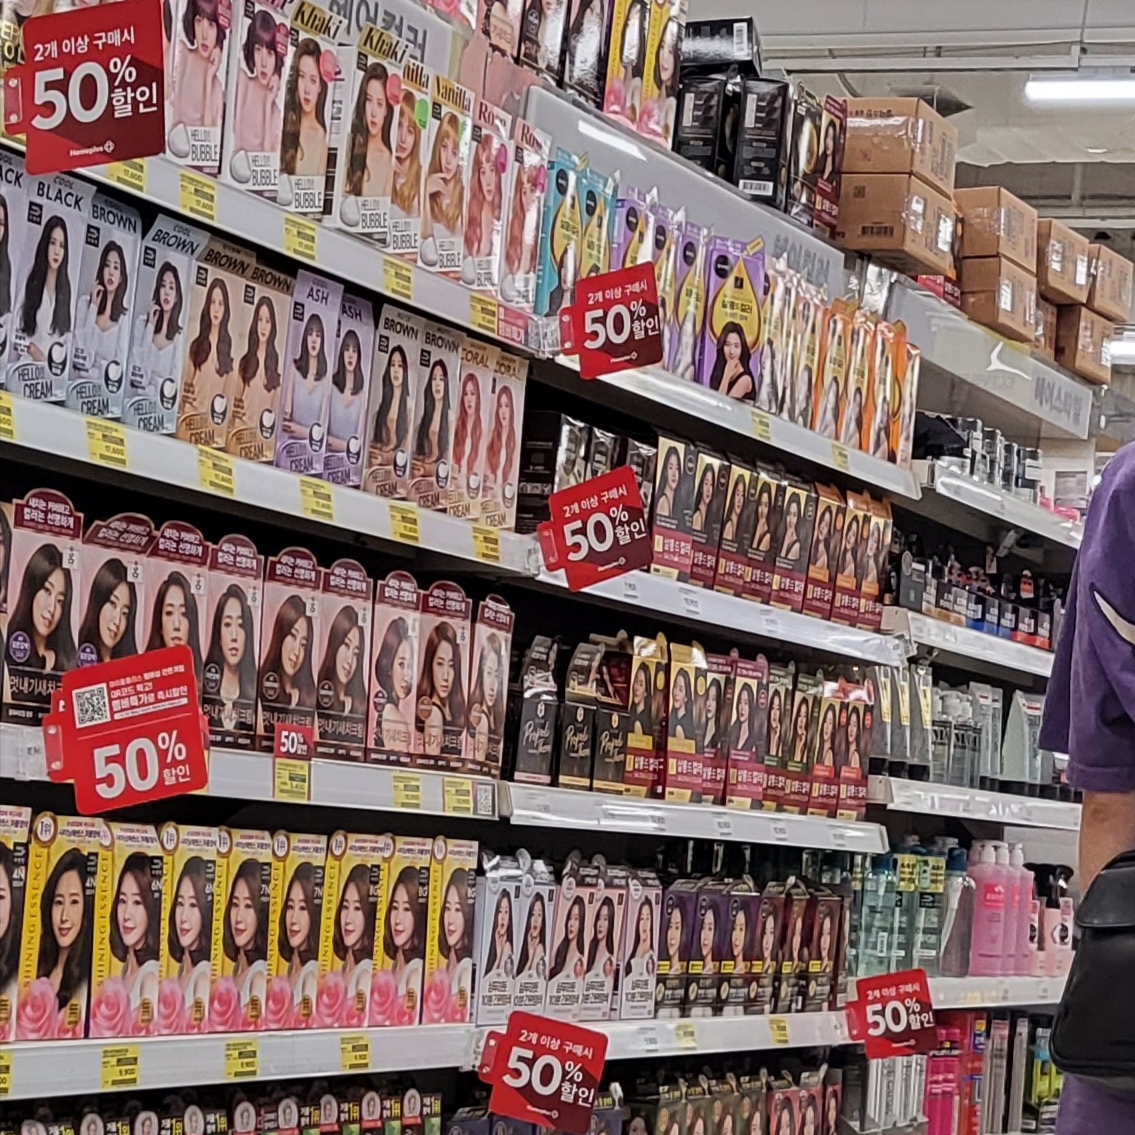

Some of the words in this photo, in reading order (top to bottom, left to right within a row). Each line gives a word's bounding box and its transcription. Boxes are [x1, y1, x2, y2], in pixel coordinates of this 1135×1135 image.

[293, 3, 343, 41] Khaki
[34, 43, 58, 62] 2개
[62, 35, 90, 56] 이상
[93, 26, 135, 50] 구매시
[362, 28, 410, 69] Khaki
[110, 82, 158, 119] 할인
[434, 75, 473, 114] Vanilla
[191, 144, 219, 163] BUBBLE
[53, 175, 75, 190] COOL
[251, 169, 278, 187] BUBBLE
[37, 181, 85, 211] BLACK
[294, 191, 324, 209] BUBBLE
[92, 203, 138, 233] BROWN
[361, 212, 389, 231] BUBBLE
[152, 228, 200, 256] BROWN
[204, 249, 250, 276] BROWN
[251, 266, 293, 292] BROWN
[588, 292, 603, 305] 2개
[604, 287, 622, 301] 이상
[624, 279, 648, 296] 구매시
[306, 286, 330, 305] ASH
[342, 301, 363, 322] ASH
[383, 316, 419, 340] BROWN
[632, 315, 660, 340] 할인
[425, 331, 461, 356] BROWN
[23, 382, 53, 400] CREAM
[81, 397, 109, 416] CREAM
[138, 414, 165, 432] CREAM
[563, 502, 580, 518] 2개
[581, 495, 598, 510] 이상
[600, 484, 628, 503] 구매시
[615, 518, 647, 546] 할인
[163, 764, 191, 786] 할인
[519, 1029, 538, 1044] 2개
[540, 1034, 561, 1050] 이상
[563, 1041, 594, 1060] 구매시
[560, 1081, 594, 1108] 할인
